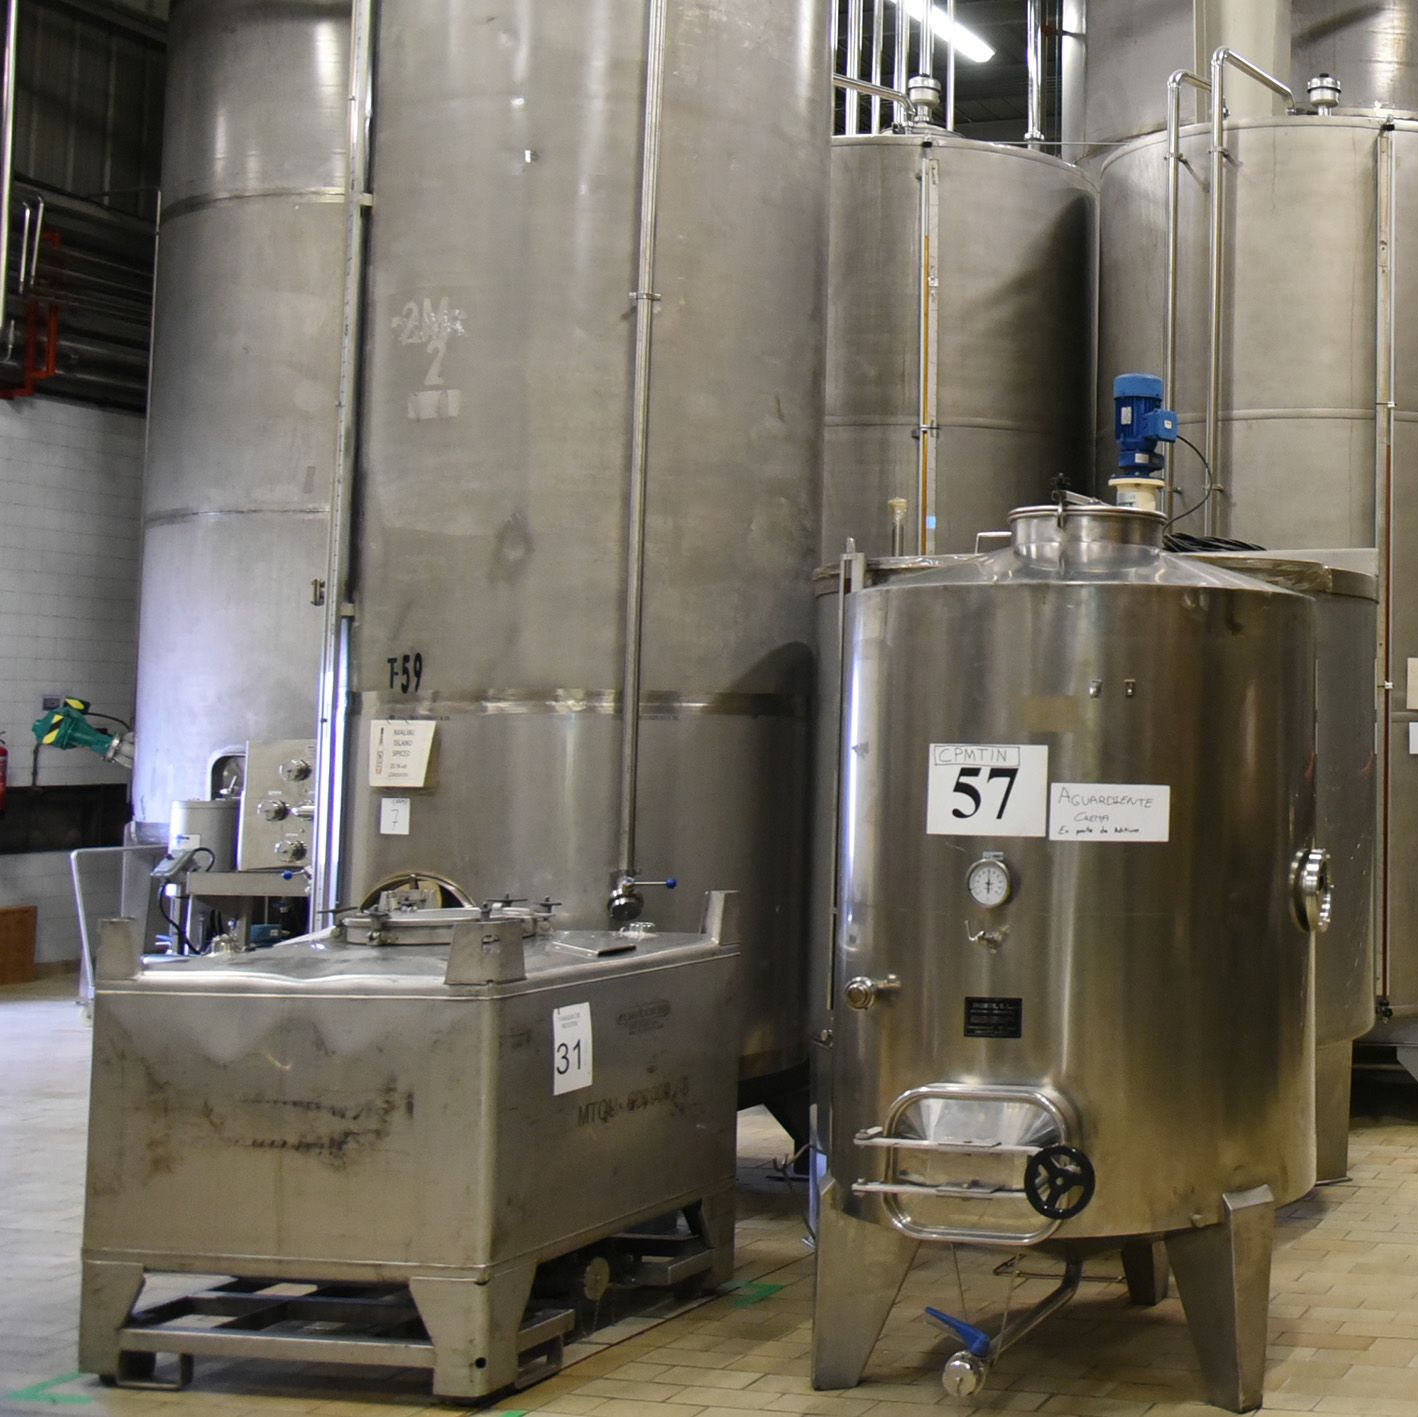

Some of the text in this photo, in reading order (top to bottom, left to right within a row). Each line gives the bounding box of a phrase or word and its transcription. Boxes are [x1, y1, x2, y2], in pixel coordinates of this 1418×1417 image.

[387, 652, 423, 694] T-59
[938, 747, 1008, 763] CPMTIN
[951, 766, 1019, 819] 57
[556, 1039, 582, 1076] 31
